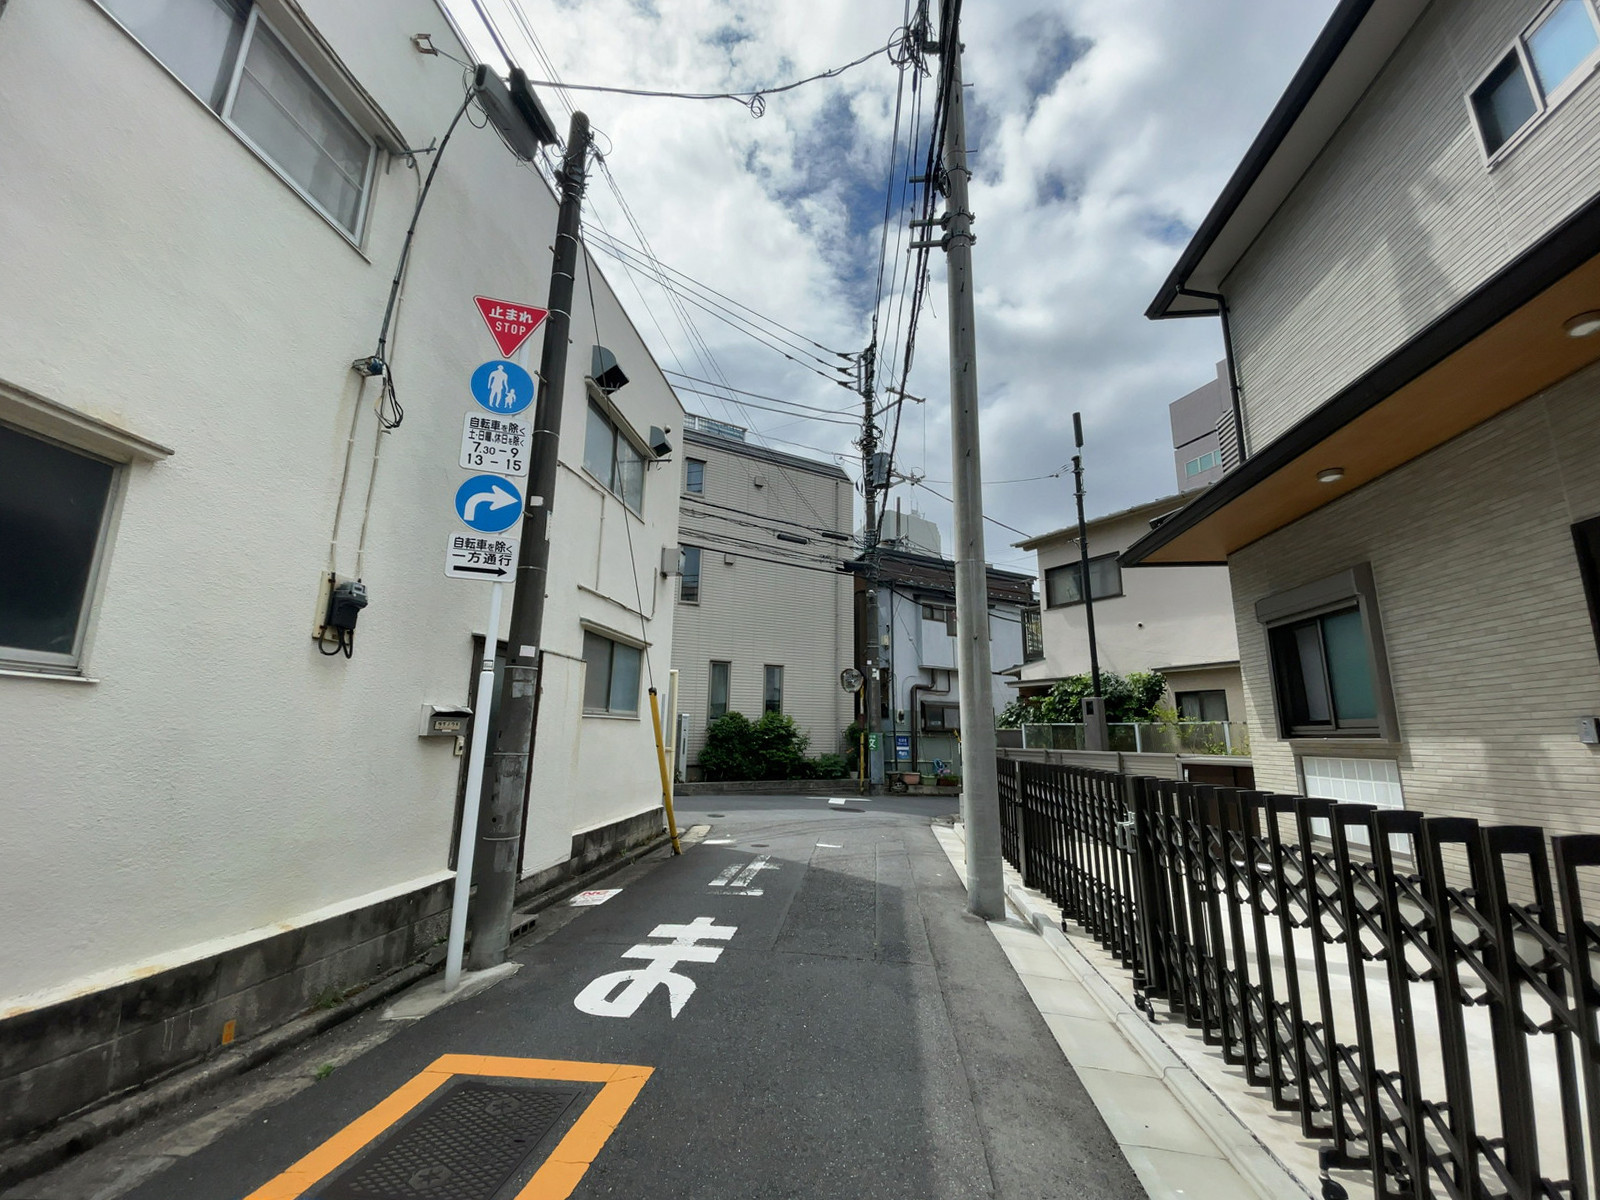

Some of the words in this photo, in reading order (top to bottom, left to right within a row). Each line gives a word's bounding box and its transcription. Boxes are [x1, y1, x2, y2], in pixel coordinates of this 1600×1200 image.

[489, 306, 533, 323] 止まれ
[495, 321, 526, 335] STOP
[470, 417, 525, 435] 自転車を除く
[453, 536, 513, 553] 自転車を除く
[452, 551, 512, 567] 一方通行
